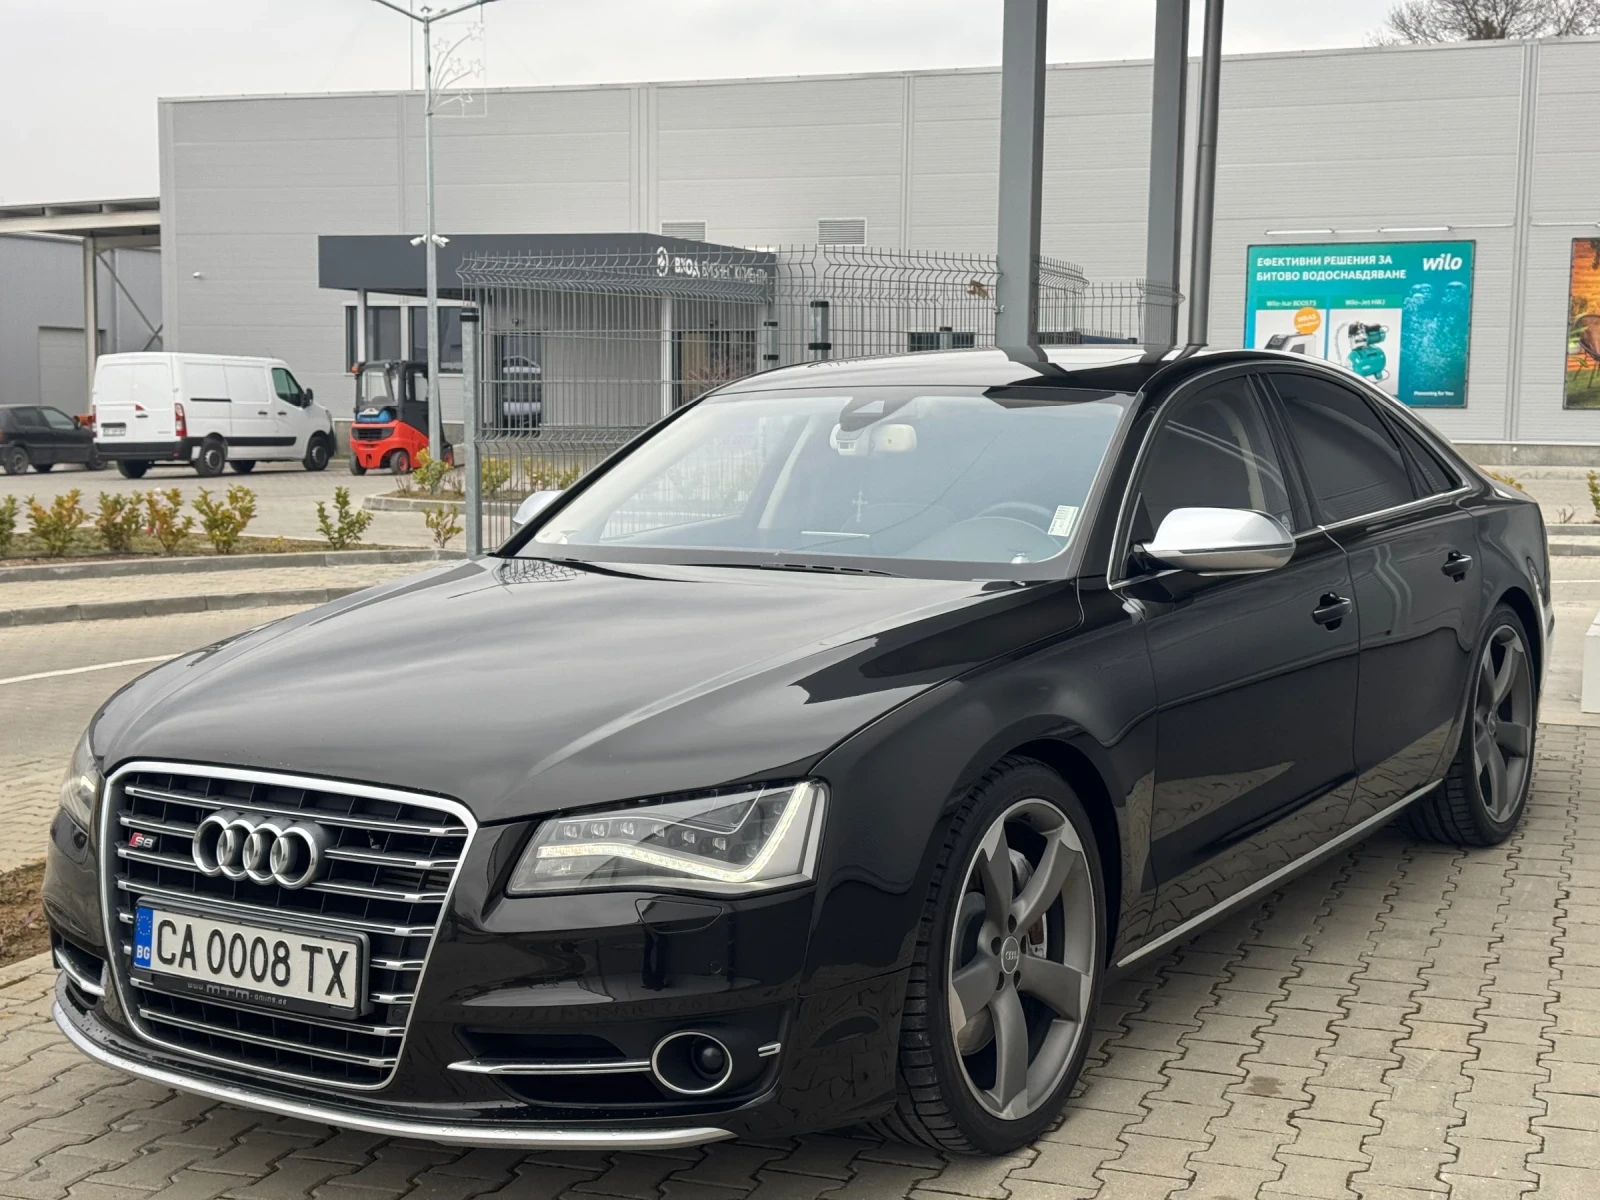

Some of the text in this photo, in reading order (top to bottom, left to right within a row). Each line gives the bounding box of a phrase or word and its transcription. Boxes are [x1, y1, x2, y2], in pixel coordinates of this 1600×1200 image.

[1257, 255, 1393, 267] ЕФЕКТИВНИ РЕШЕНИЯ ЗА
[1422, 253, 1463, 271] wilo
[1256, 269, 1407, 281] БИТОВО ВОДОСНАБДЯВАНЕ
[135, 836, 154, 848] S8
[136, 944, 151, 960] BG
[156, 919, 349, 1000] CA 0008 TX
